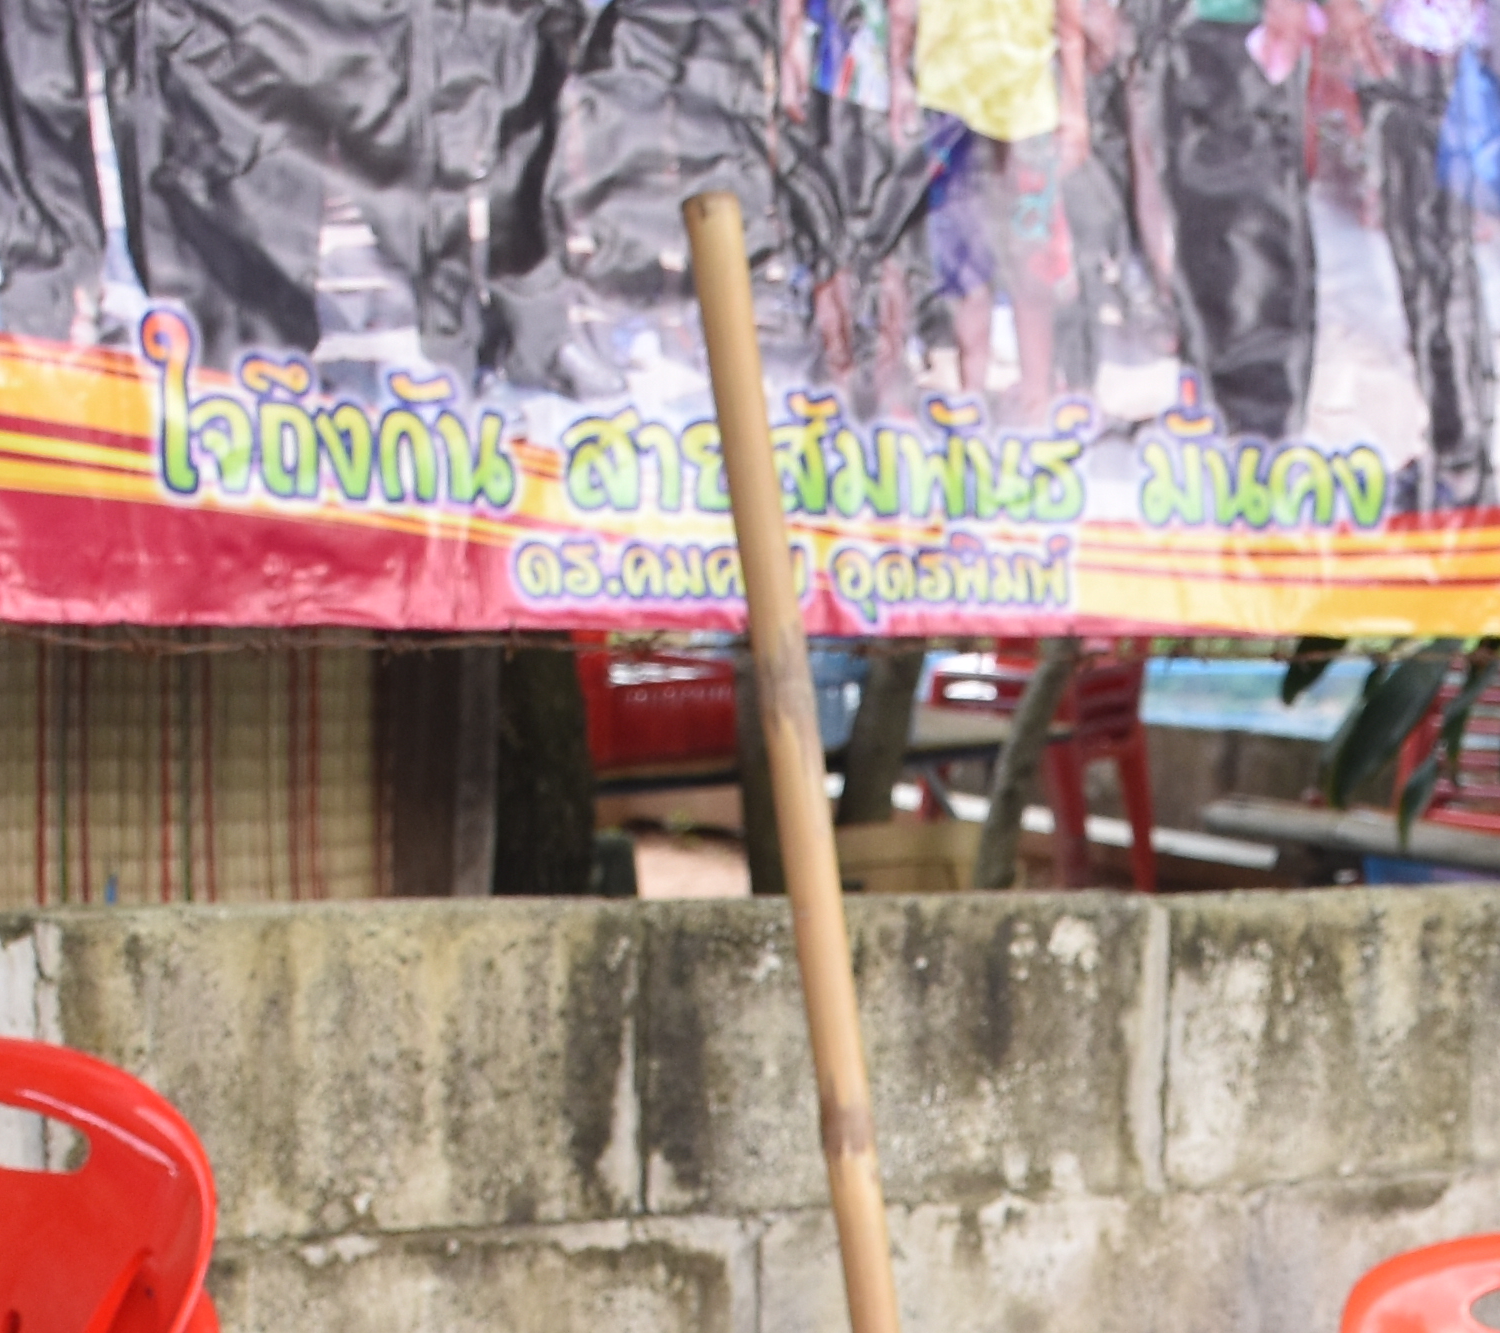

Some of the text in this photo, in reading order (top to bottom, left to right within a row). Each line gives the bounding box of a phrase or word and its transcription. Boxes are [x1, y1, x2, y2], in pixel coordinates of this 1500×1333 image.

[141, 309, 516, 508] ใจถึงกัน
[1140, 374, 1386, 530] มั่นคง
[514, 540, 806, 601] ดร.คมค
